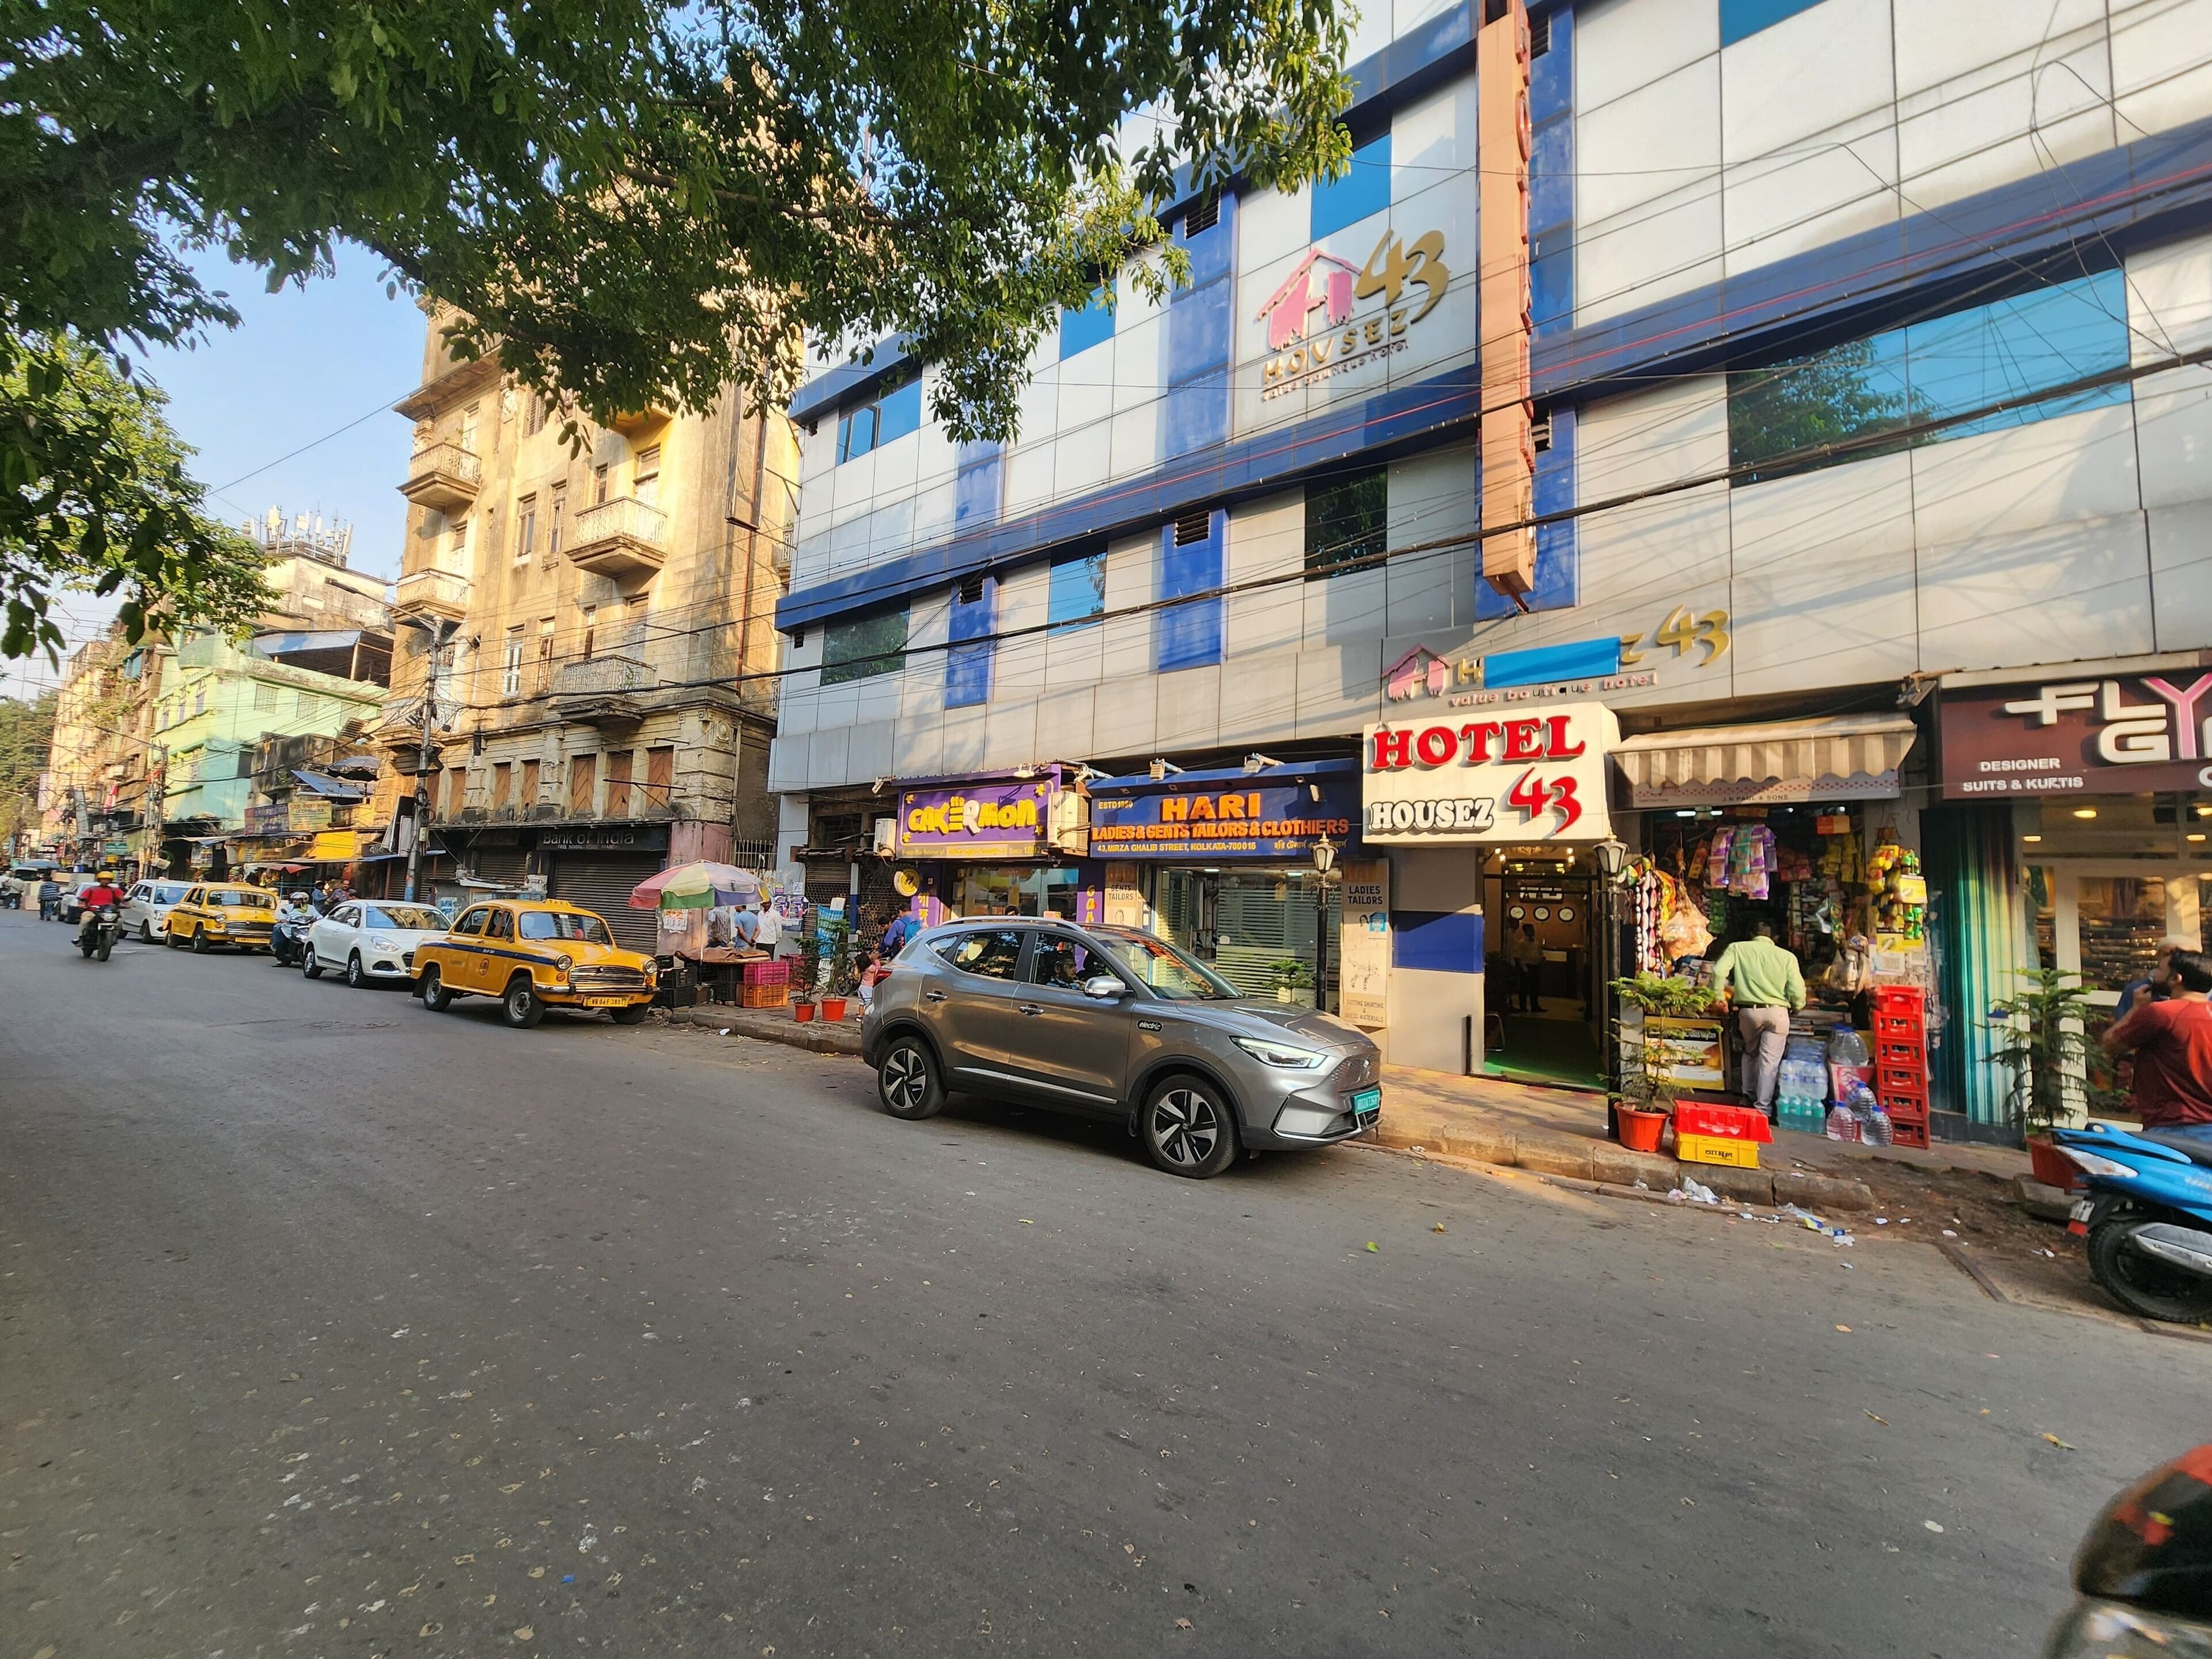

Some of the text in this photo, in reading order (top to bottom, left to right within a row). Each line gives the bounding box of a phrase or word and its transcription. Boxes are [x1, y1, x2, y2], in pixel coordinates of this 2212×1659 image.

[1355, 229, 1450, 324] 43
[1263, 308, 1407, 384] HOUSEZ
[1657, 605, 1730, 667] 43
[1450, 671, 1658, 708] value boutique hotel
[1371, 715, 1586, 770] HOTEL
[1979, 757, 2061, 772] DESIGNER
[1963, 776, 2084, 792] SUITS & KURTIS
[1162, 793, 1260, 821] HARI
[1370, 766, 1583, 835] HOUSEZ 43
[543, 831, 634, 845] Bank of India
[1092, 825, 1135, 840] LADIES
[1146, 824, 1190, 839] GENTS
[1191, 821, 1248, 838] TAILORS
[1249, 820, 1260, 837] &
[1262, 818, 1350, 836] CLOTHIERS
[1131, 843, 1158, 852] GHALIB
[1159, 843, 1190, 852] STREET,
[1347, 896, 1383, 905] TAILORS
[1349, 885, 1381, 895] LADIES
[1139, 1021, 1161, 1030] electric
